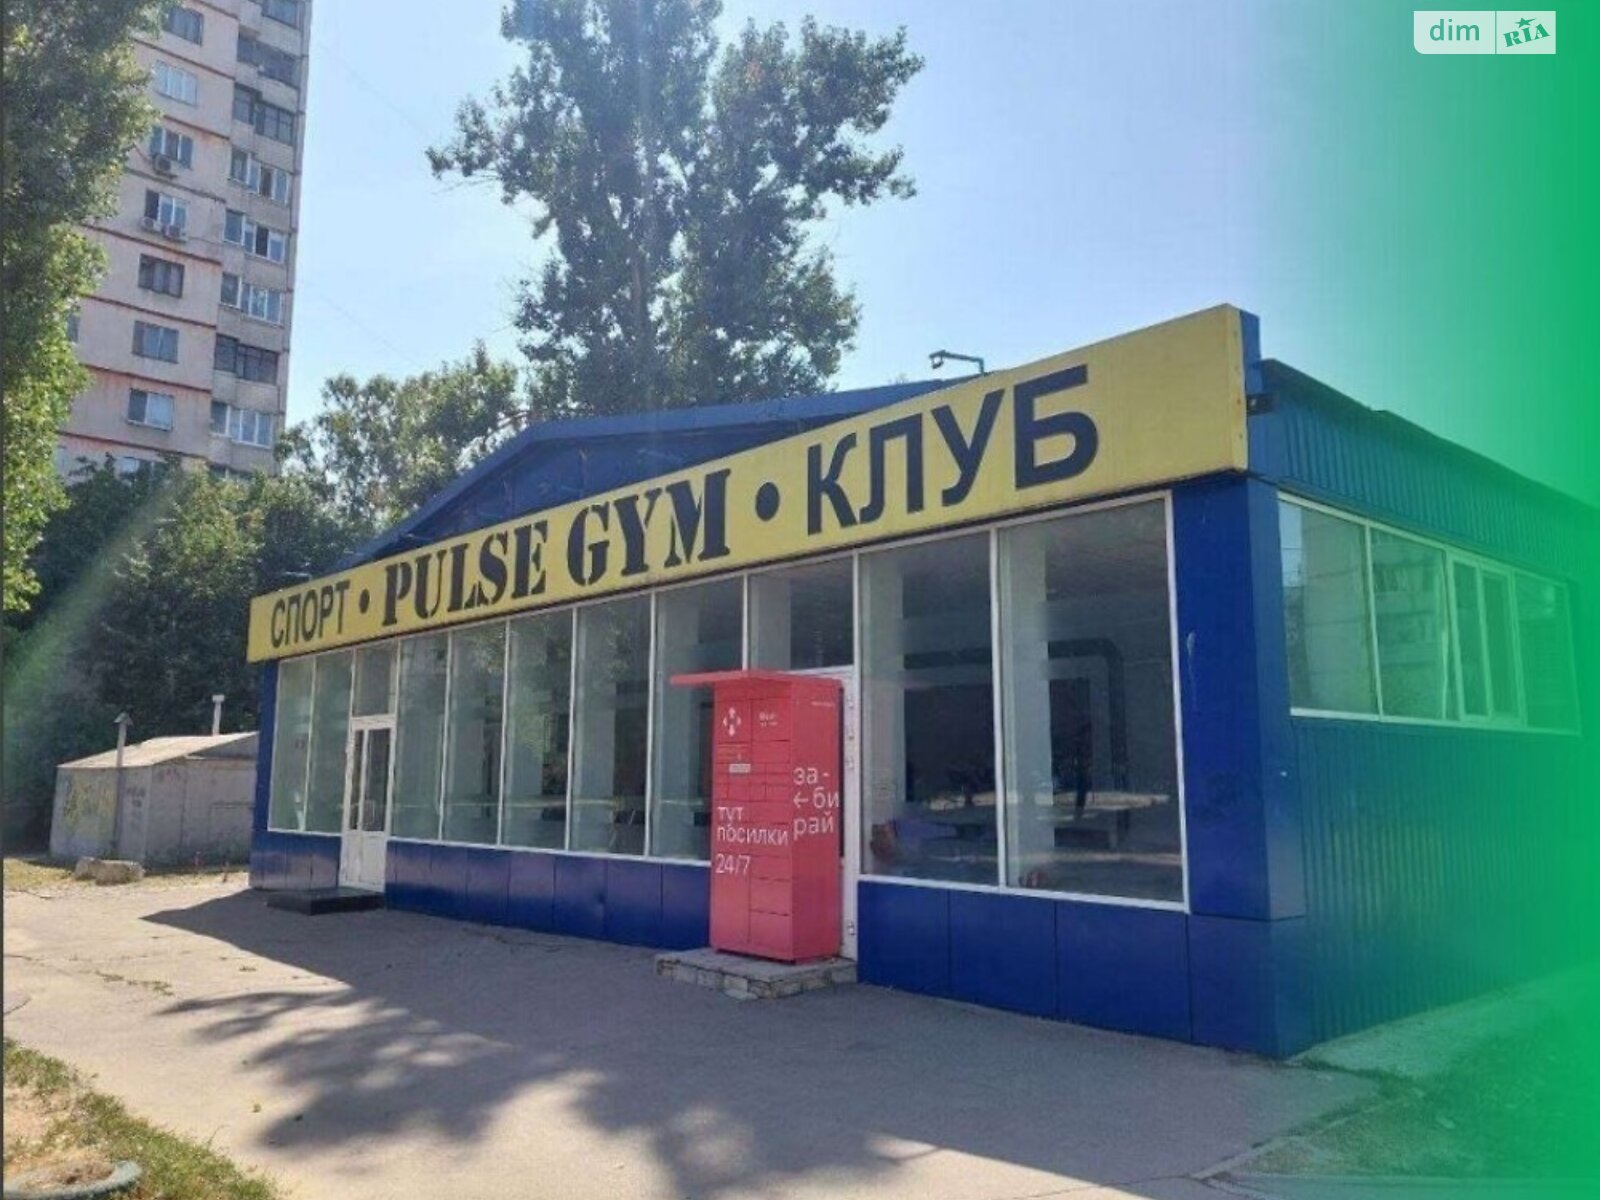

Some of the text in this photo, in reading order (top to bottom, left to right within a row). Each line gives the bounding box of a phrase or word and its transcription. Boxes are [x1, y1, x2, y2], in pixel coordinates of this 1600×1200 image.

[271, 364, 1099, 648] СПОРТ PULSE GYM КЛУБ
[813, 786, 839, 809] би
[717, 806, 743, 826] тут
[793, 811, 834, 841] рай
[717, 825, 789, 846] посилки
[715, 853, 751, 875] 24/7
